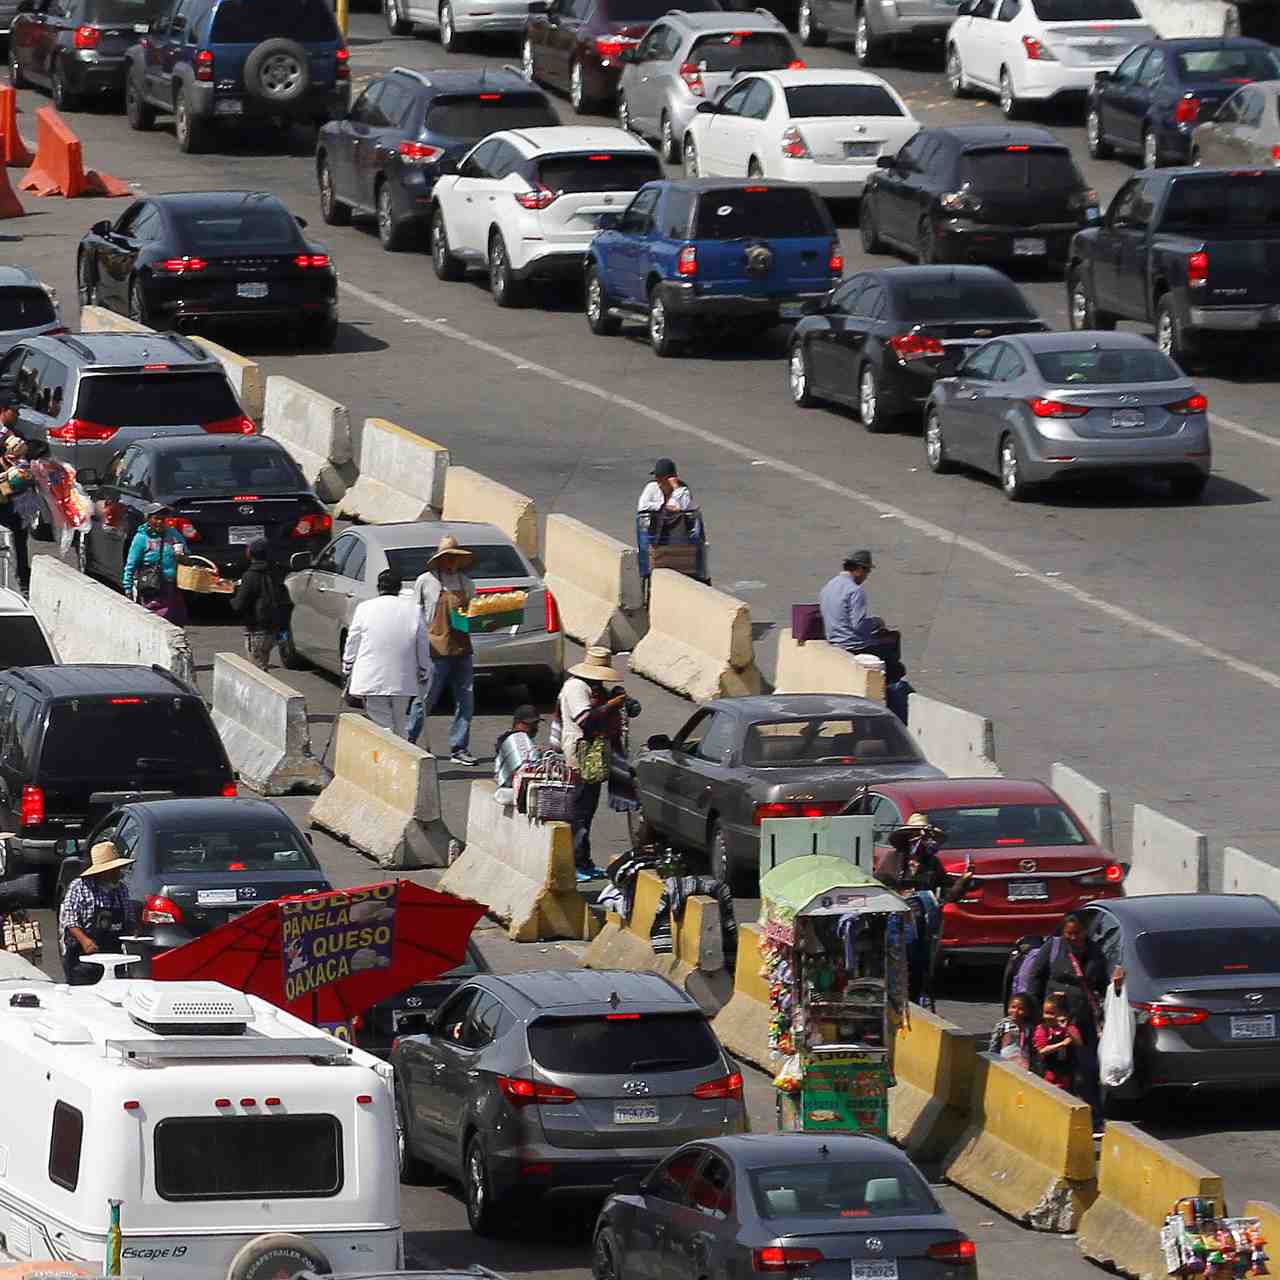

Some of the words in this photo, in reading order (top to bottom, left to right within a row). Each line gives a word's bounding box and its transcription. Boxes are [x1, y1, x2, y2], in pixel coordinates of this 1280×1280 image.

[282, 909, 351, 943] PANELA
[312, 926, 392, 958] QUESO
[285, 955, 351, 1001] OAXACA
[121, 1246, 171, 1260] Escape
[171, 1245, 188, 1258] 19
